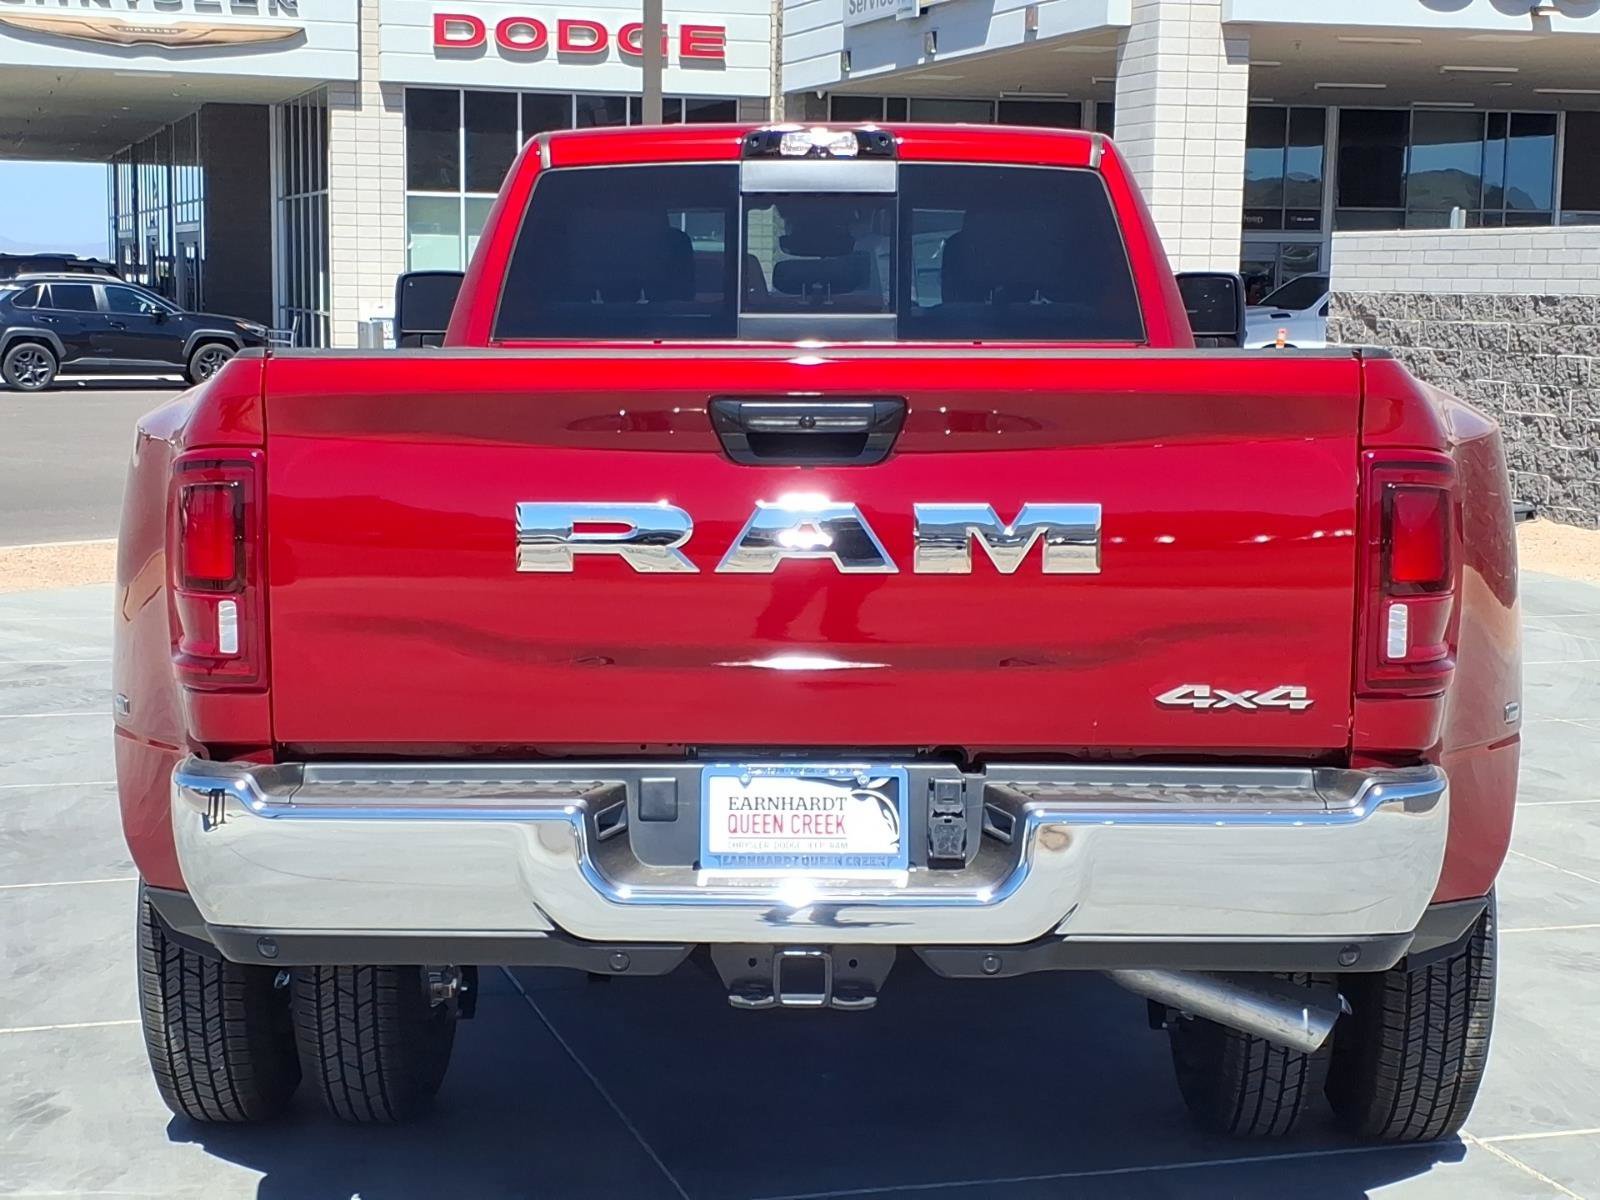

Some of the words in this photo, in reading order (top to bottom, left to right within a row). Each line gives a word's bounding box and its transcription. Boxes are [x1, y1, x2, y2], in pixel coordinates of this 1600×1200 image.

[432, 13, 726, 58] DODGE
[515, 501, 1102, 574] RAM
[1155, 684, 1314, 709] 4x4
[728, 796, 847, 811] EARNHARDT
[728, 813, 784, 834] QUEEN
[791, 814, 846, 835] CREEK
[801, 856, 842, 867] QUEEN
